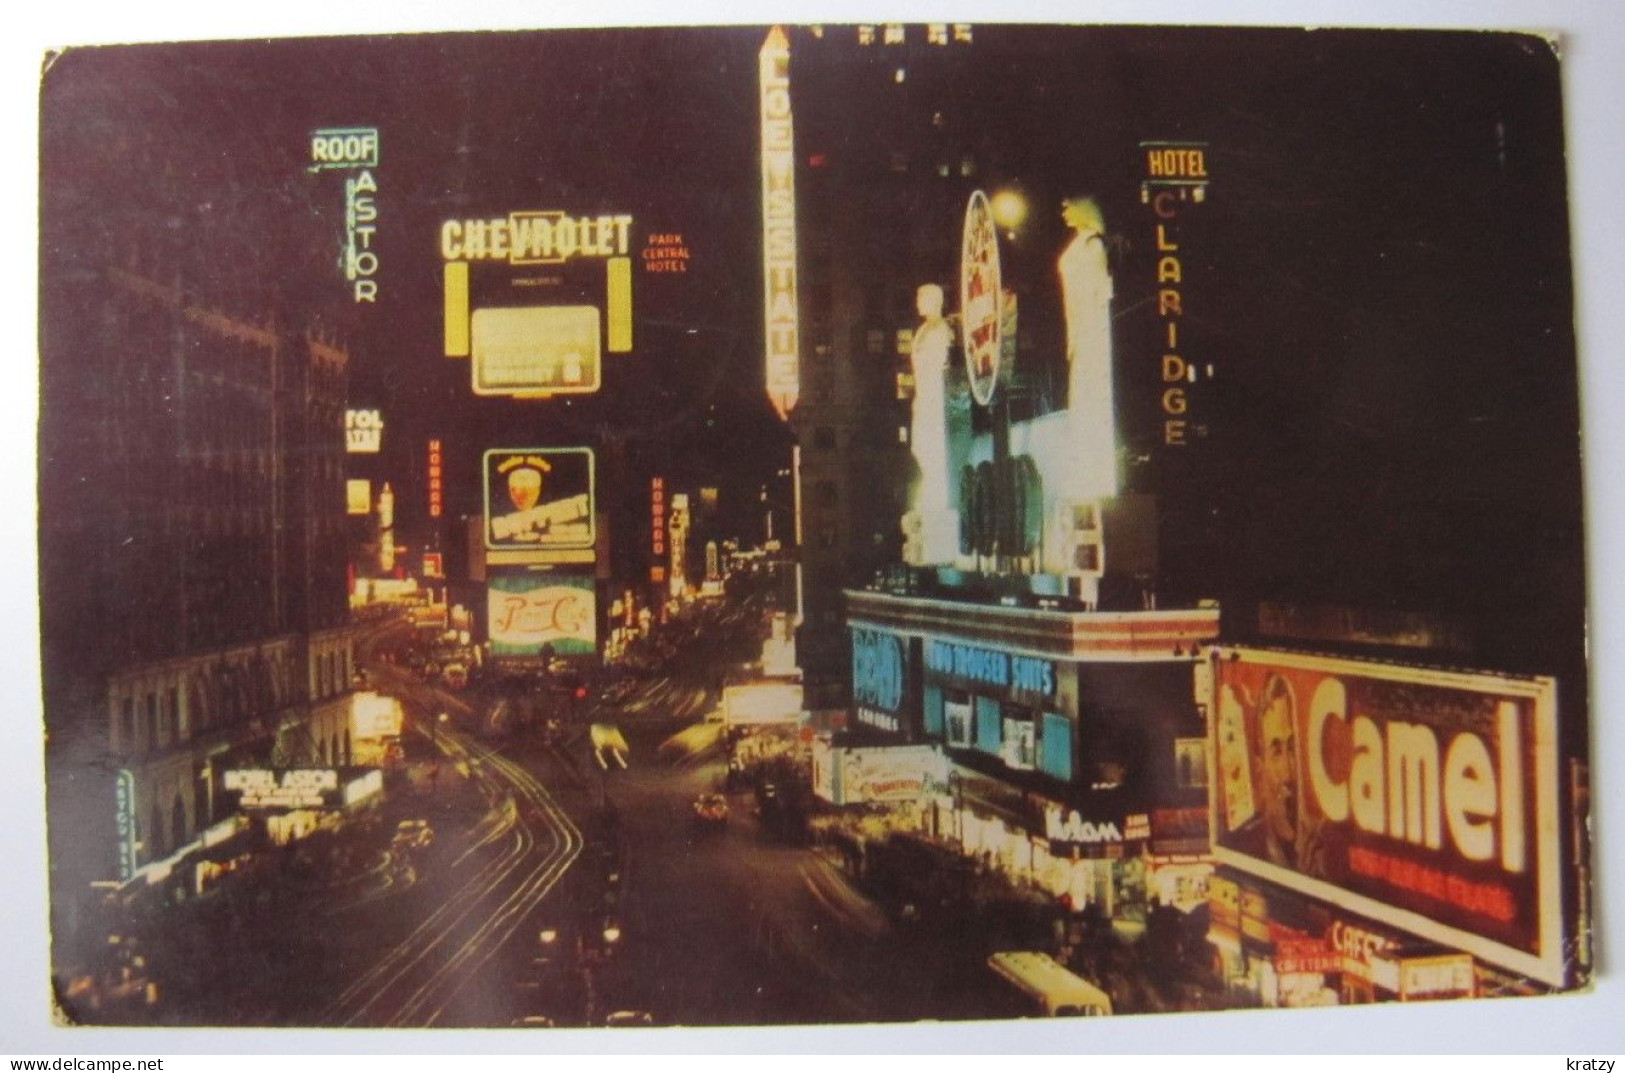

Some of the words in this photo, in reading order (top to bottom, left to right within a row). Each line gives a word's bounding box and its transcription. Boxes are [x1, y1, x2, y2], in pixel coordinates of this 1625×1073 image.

[312, 136, 375, 162] ROOF
[1149, 149, 1207, 177] HOTEL
[354, 171, 378, 303] ASTOR
[441, 214, 633, 261] CHEVROLET
[648, 234, 682, 245] PARK
[641, 248, 691, 259] CENTRAL
[646, 260, 687, 272] HOTEL
[1154, 192, 1187, 446] CLARIDGE
[1307, 677, 1525, 873] Camel
